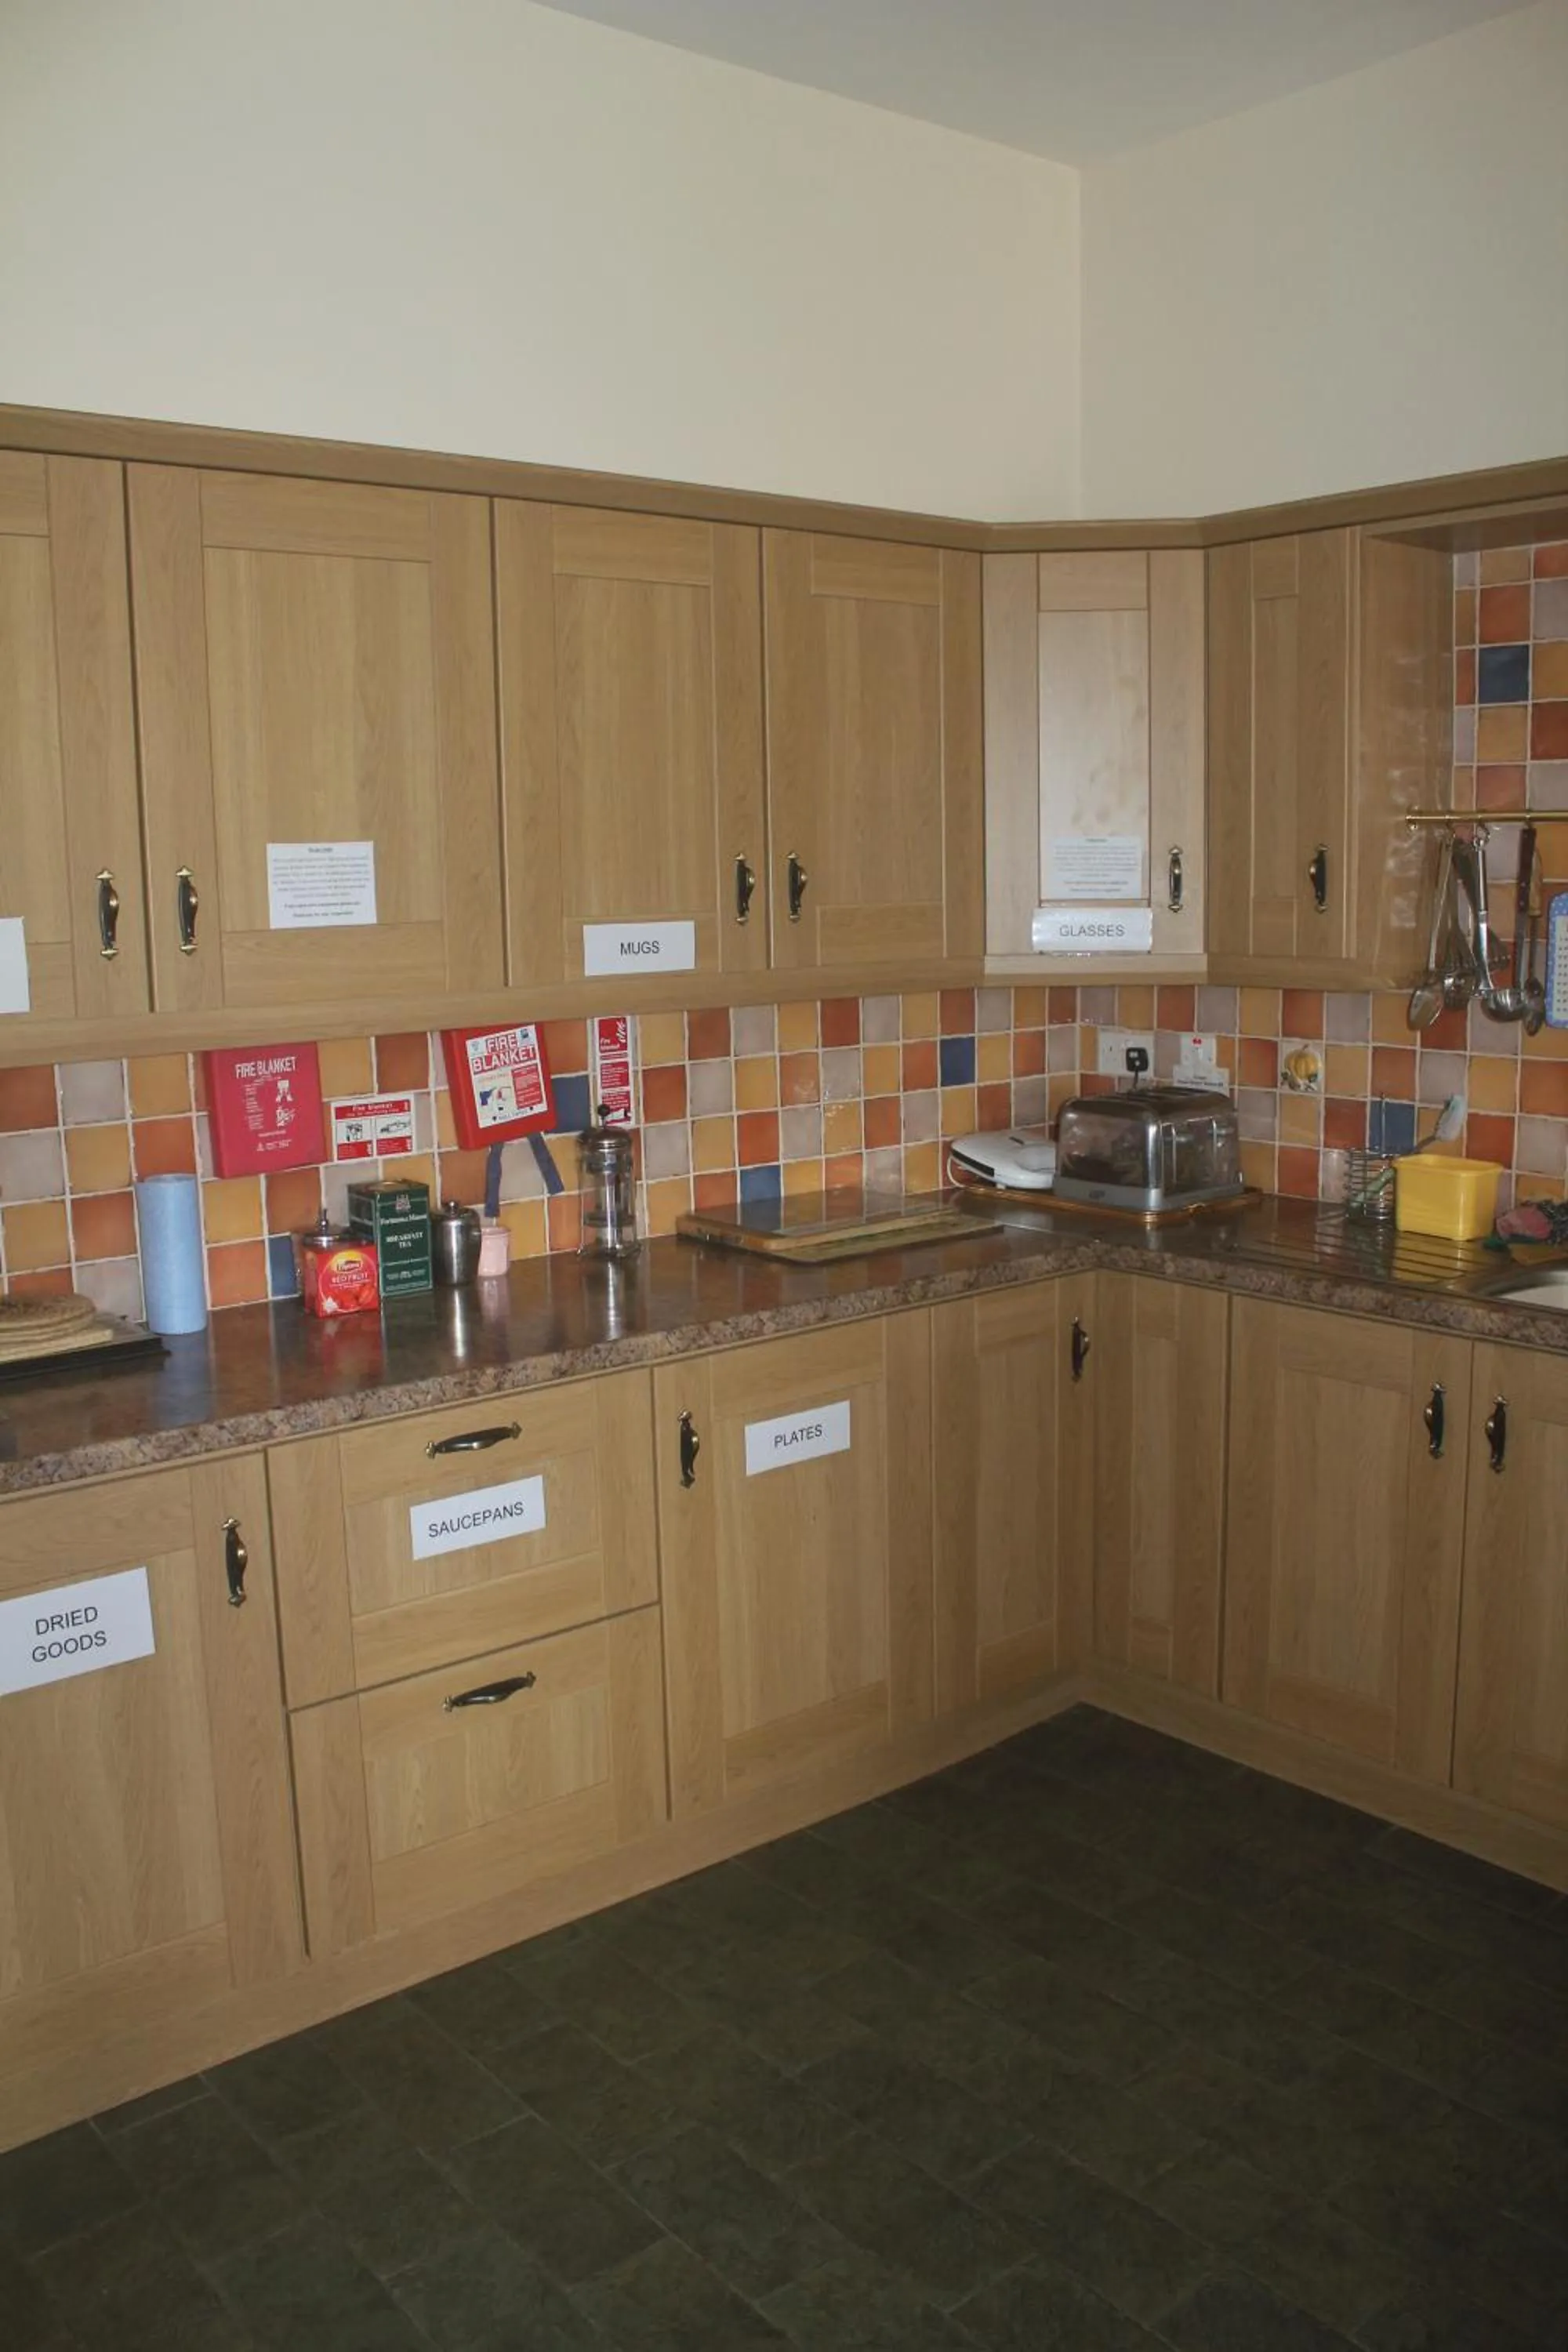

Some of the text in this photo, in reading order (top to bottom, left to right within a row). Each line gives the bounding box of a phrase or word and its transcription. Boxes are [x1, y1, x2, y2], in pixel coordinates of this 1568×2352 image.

[1060, 924, 1126, 938] GLASSES
[620, 940, 660, 956] MUGS
[486, 1033, 518, 1053] FIRE
[235, 1056, 297, 1079] FIRE BLANKET
[472, 1046, 535, 1073] BLANKET
[774, 1424, 823, 1448] PLATES
[428, 1501, 524, 1538] SAUCEPANS
[35, 1606, 98, 1635] DRIED
[32, 1630, 107, 1663] GOODS
